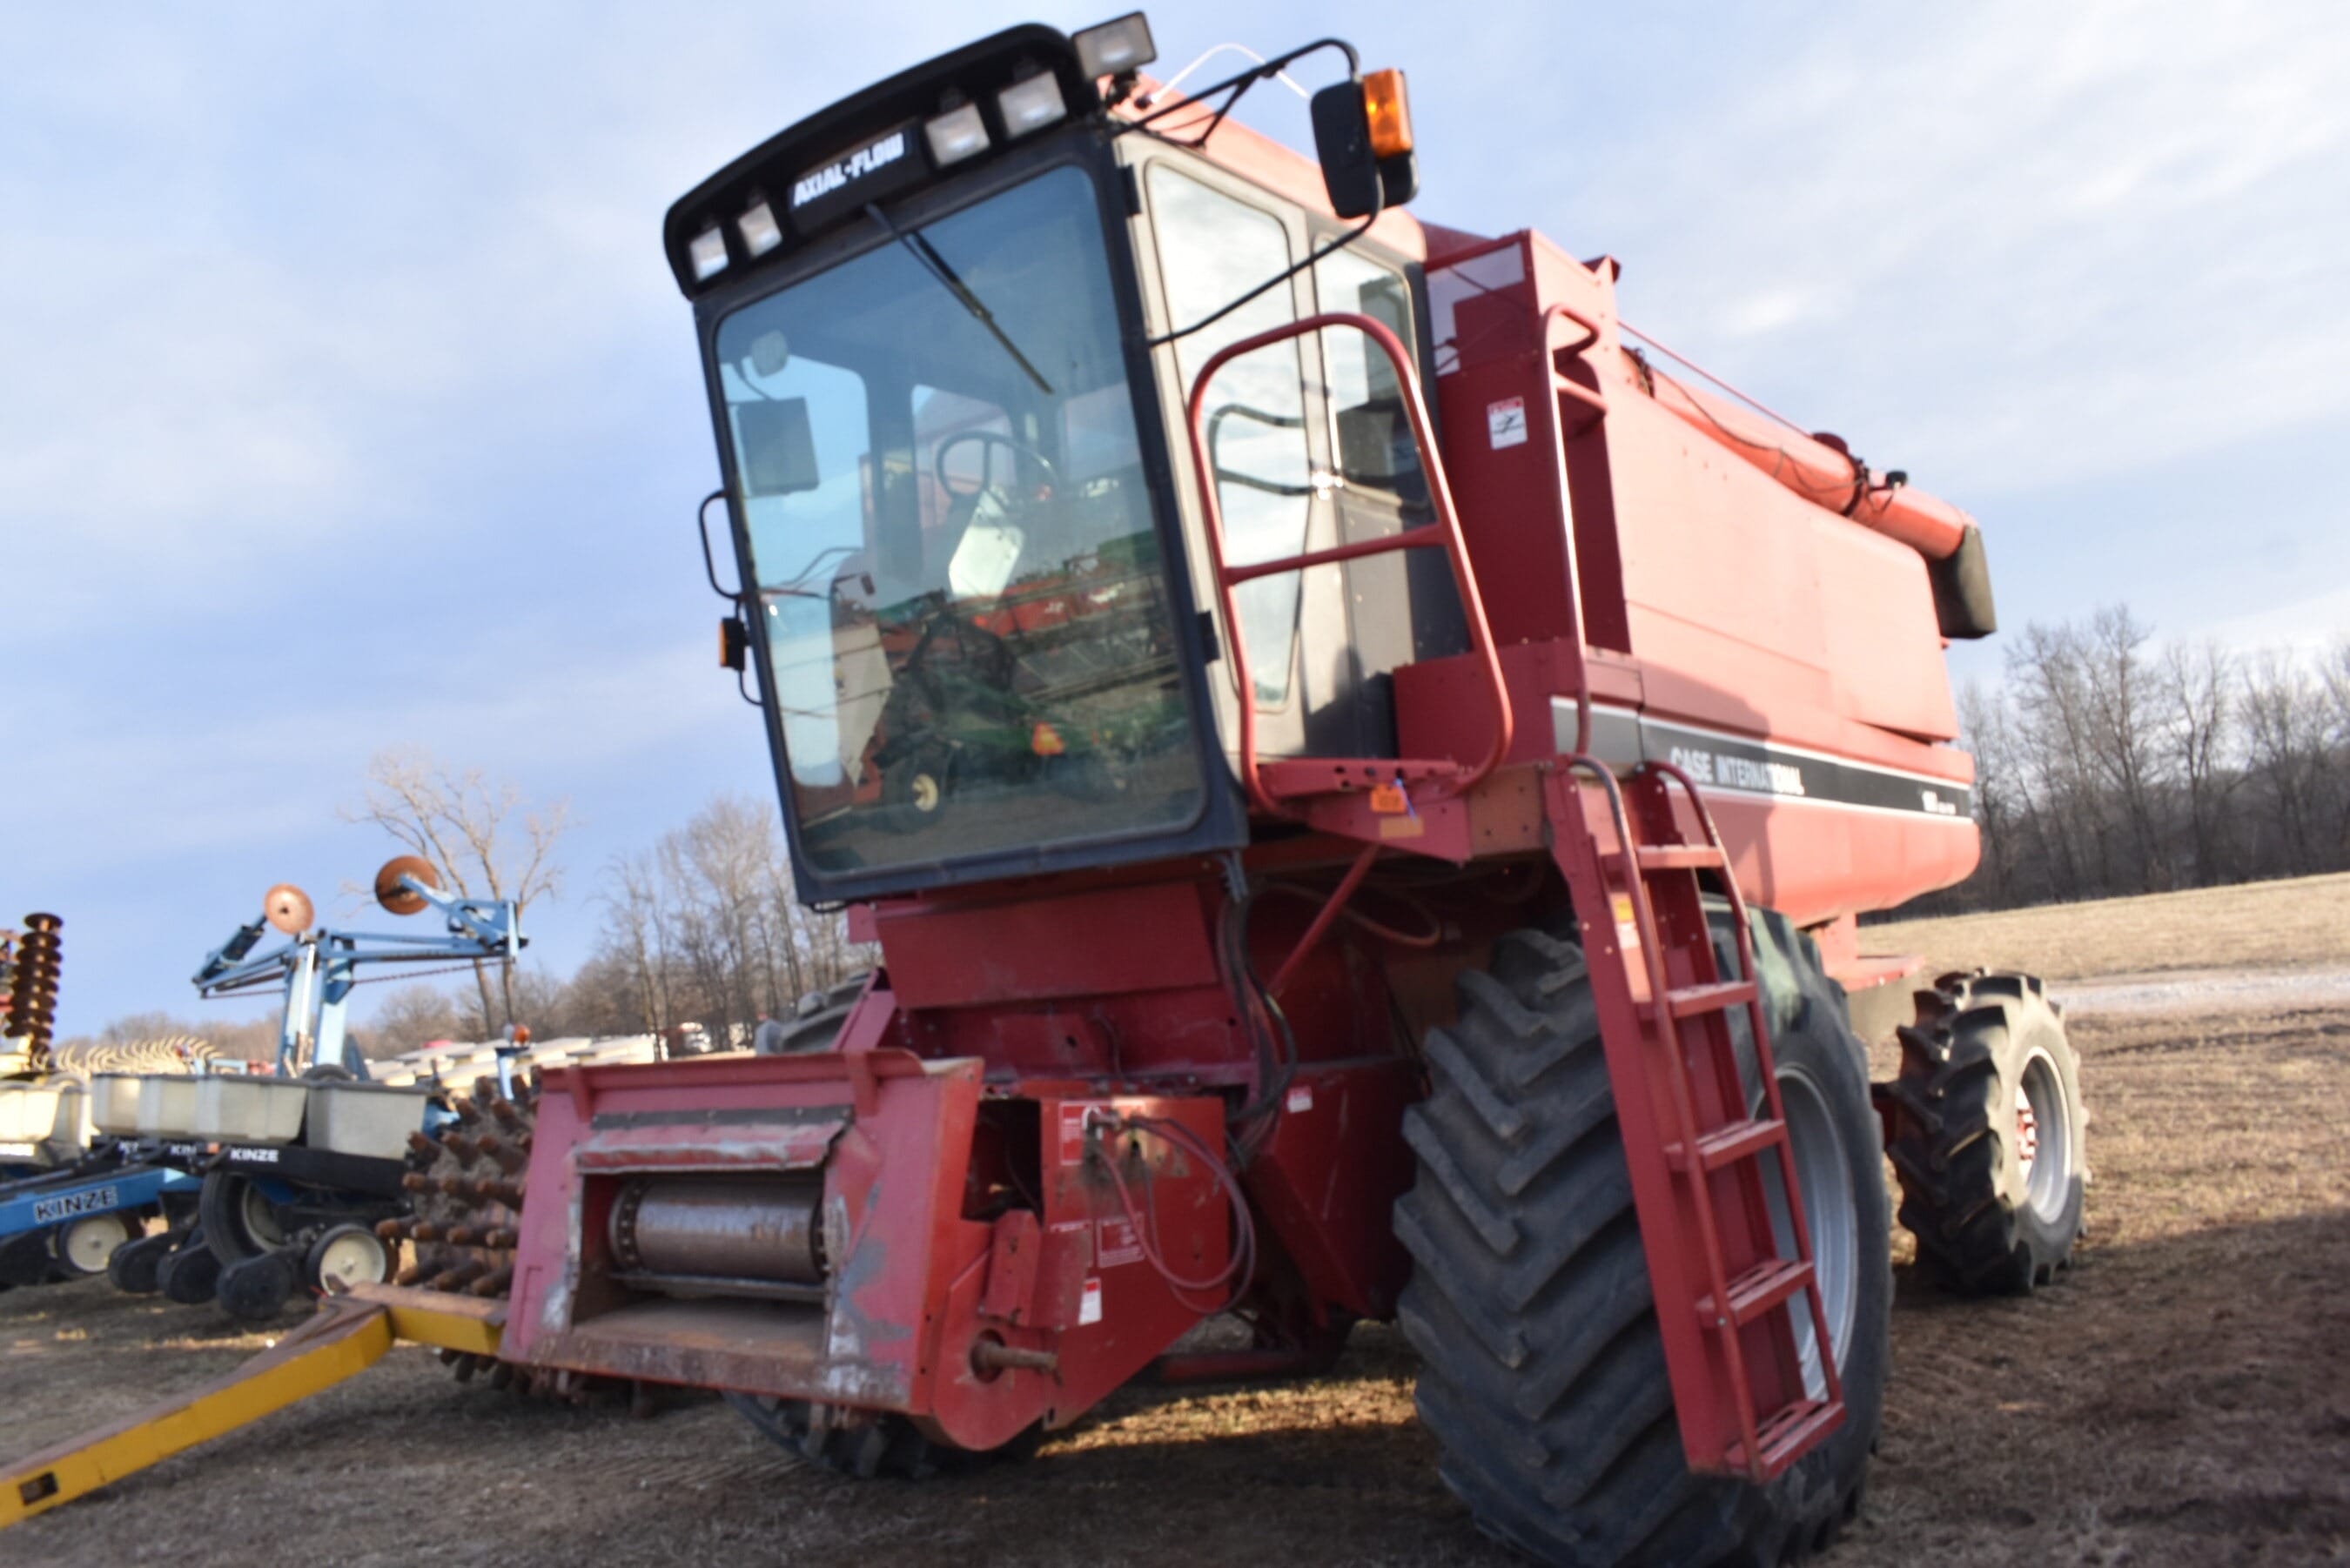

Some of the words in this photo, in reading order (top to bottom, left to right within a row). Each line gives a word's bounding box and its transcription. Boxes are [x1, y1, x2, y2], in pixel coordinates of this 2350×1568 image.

[793, 131, 905, 207] AXIAL-FLOW
[1670, 746, 1714, 783] CASE
[1715, 754, 1805, 795] INTERNATIONAL
[230, 1147, 279, 1163] KINZE
[35, 1185, 120, 1223] KINZE
